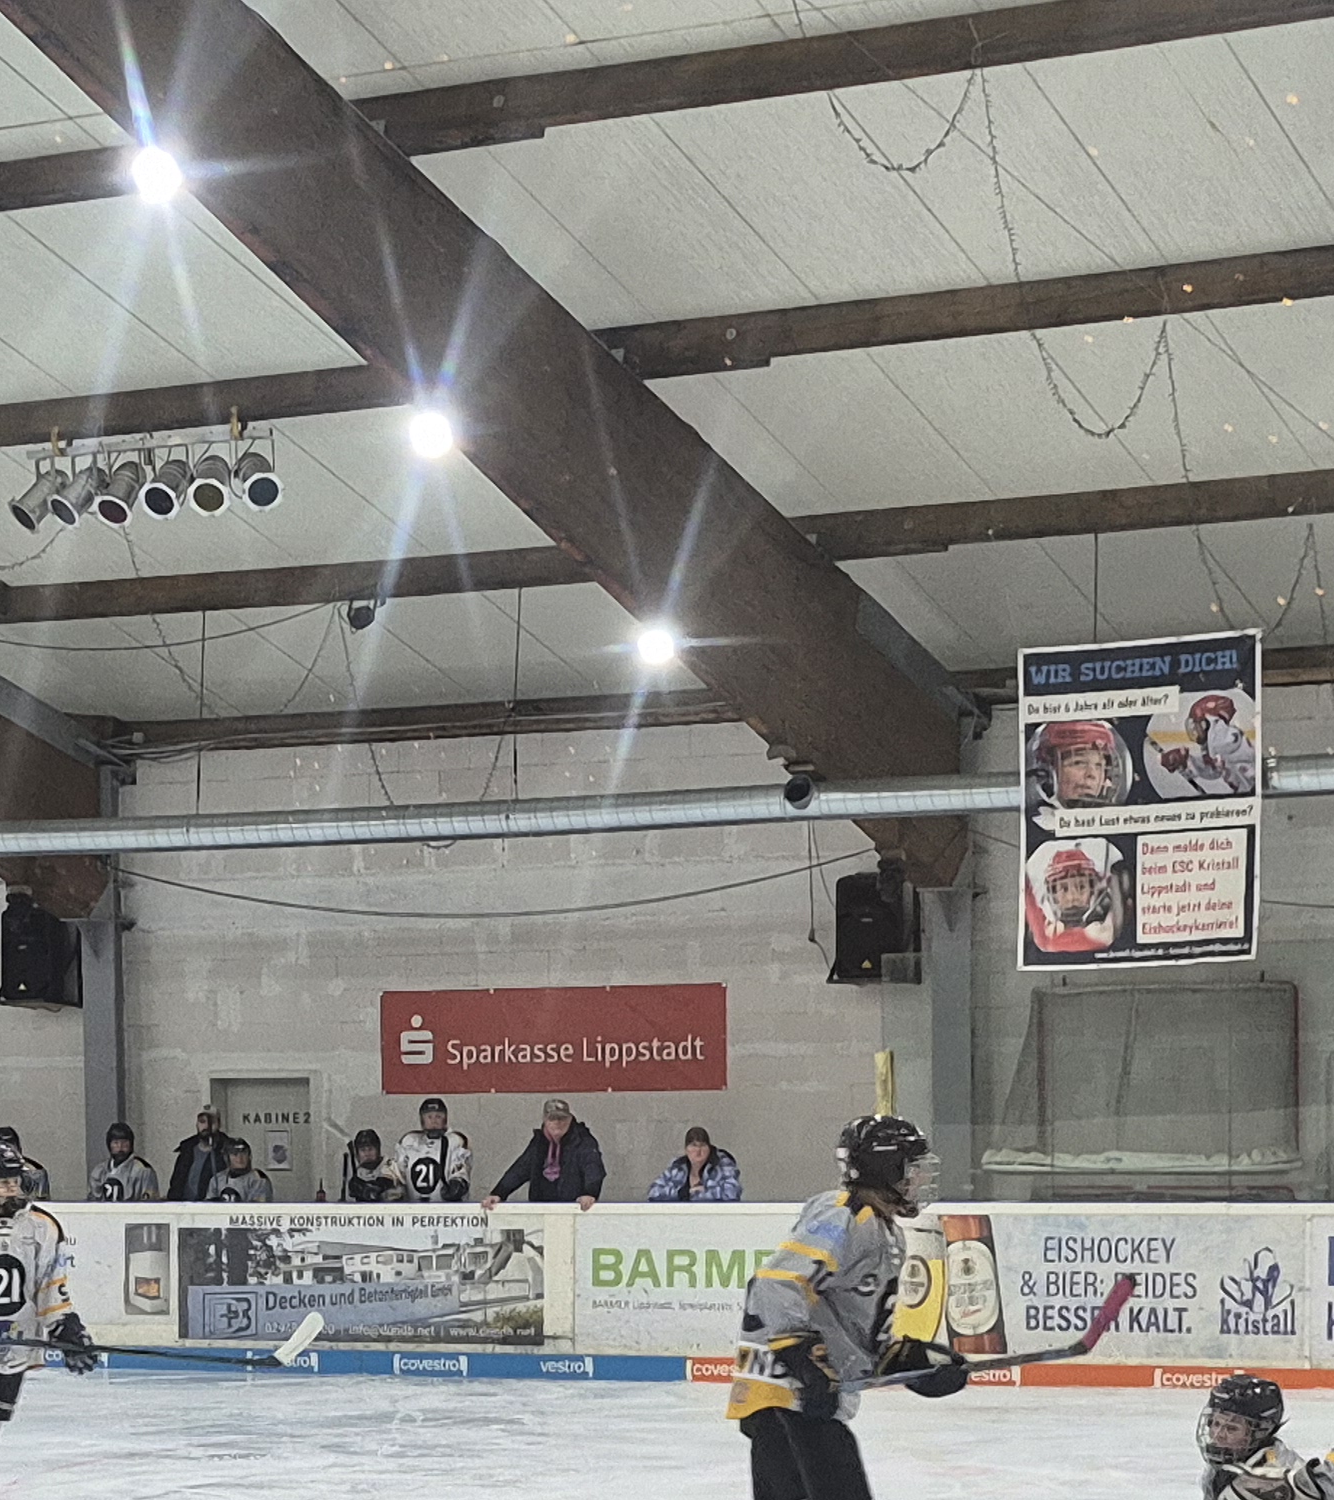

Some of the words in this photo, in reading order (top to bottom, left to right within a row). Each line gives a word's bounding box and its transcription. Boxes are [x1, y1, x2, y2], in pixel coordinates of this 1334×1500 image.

[1029, 664, 1072, 686] WIR
[1079, 655, 1171, 682] SUCHEN
[1178, 649, 1238, 674] DICH!
[1099, 813, 1121, 827] Lust
[1123, 813, 1151, 825] etwas
[1208, 838, 1233, 851] dich
[1141, 862, 1168, 876] beim
[1198, 857, 1240, 872] Kristall
[1141, 881, 1192, 898] Lippstadt
[1195, 878, 1216, 892] und
[1141, 902, 1173, 916] starte
[1175, 901, 1202, 917] jetzt
[1204, 899, 1234, 912] deine
[446, 1037, 574, 1070] Sparkasse
[582, 1034, 705, 1068] Lippstadt
[414, 1163, 435, 1188] 21
[229, 1215, 284, 1228] MASSIVE
[289, 1215, 385, 1228] KONSTRUKTION
[391, 1215, 405, 1228] IN
[411, 1215, 489, 1228] PERFEKTION
[1043, 1235, 1176, 1265] EISHOCKEY
[1020, 1270, 1037, 1297] &
[1045, 1270, 1105, 1299] BIER:
[265, 1289, 326, 1312] Decken
[330, 1288, 355, 1306] und
[1128, 1306, 1193, 1334] KALT.
[1219, 1298, 1298, 1336] kristall
[399, 1356, 460, 1372] covestro
[692, 1362, 738, 1376] coves
[1162, 1371, 1231, 1387] covestr
